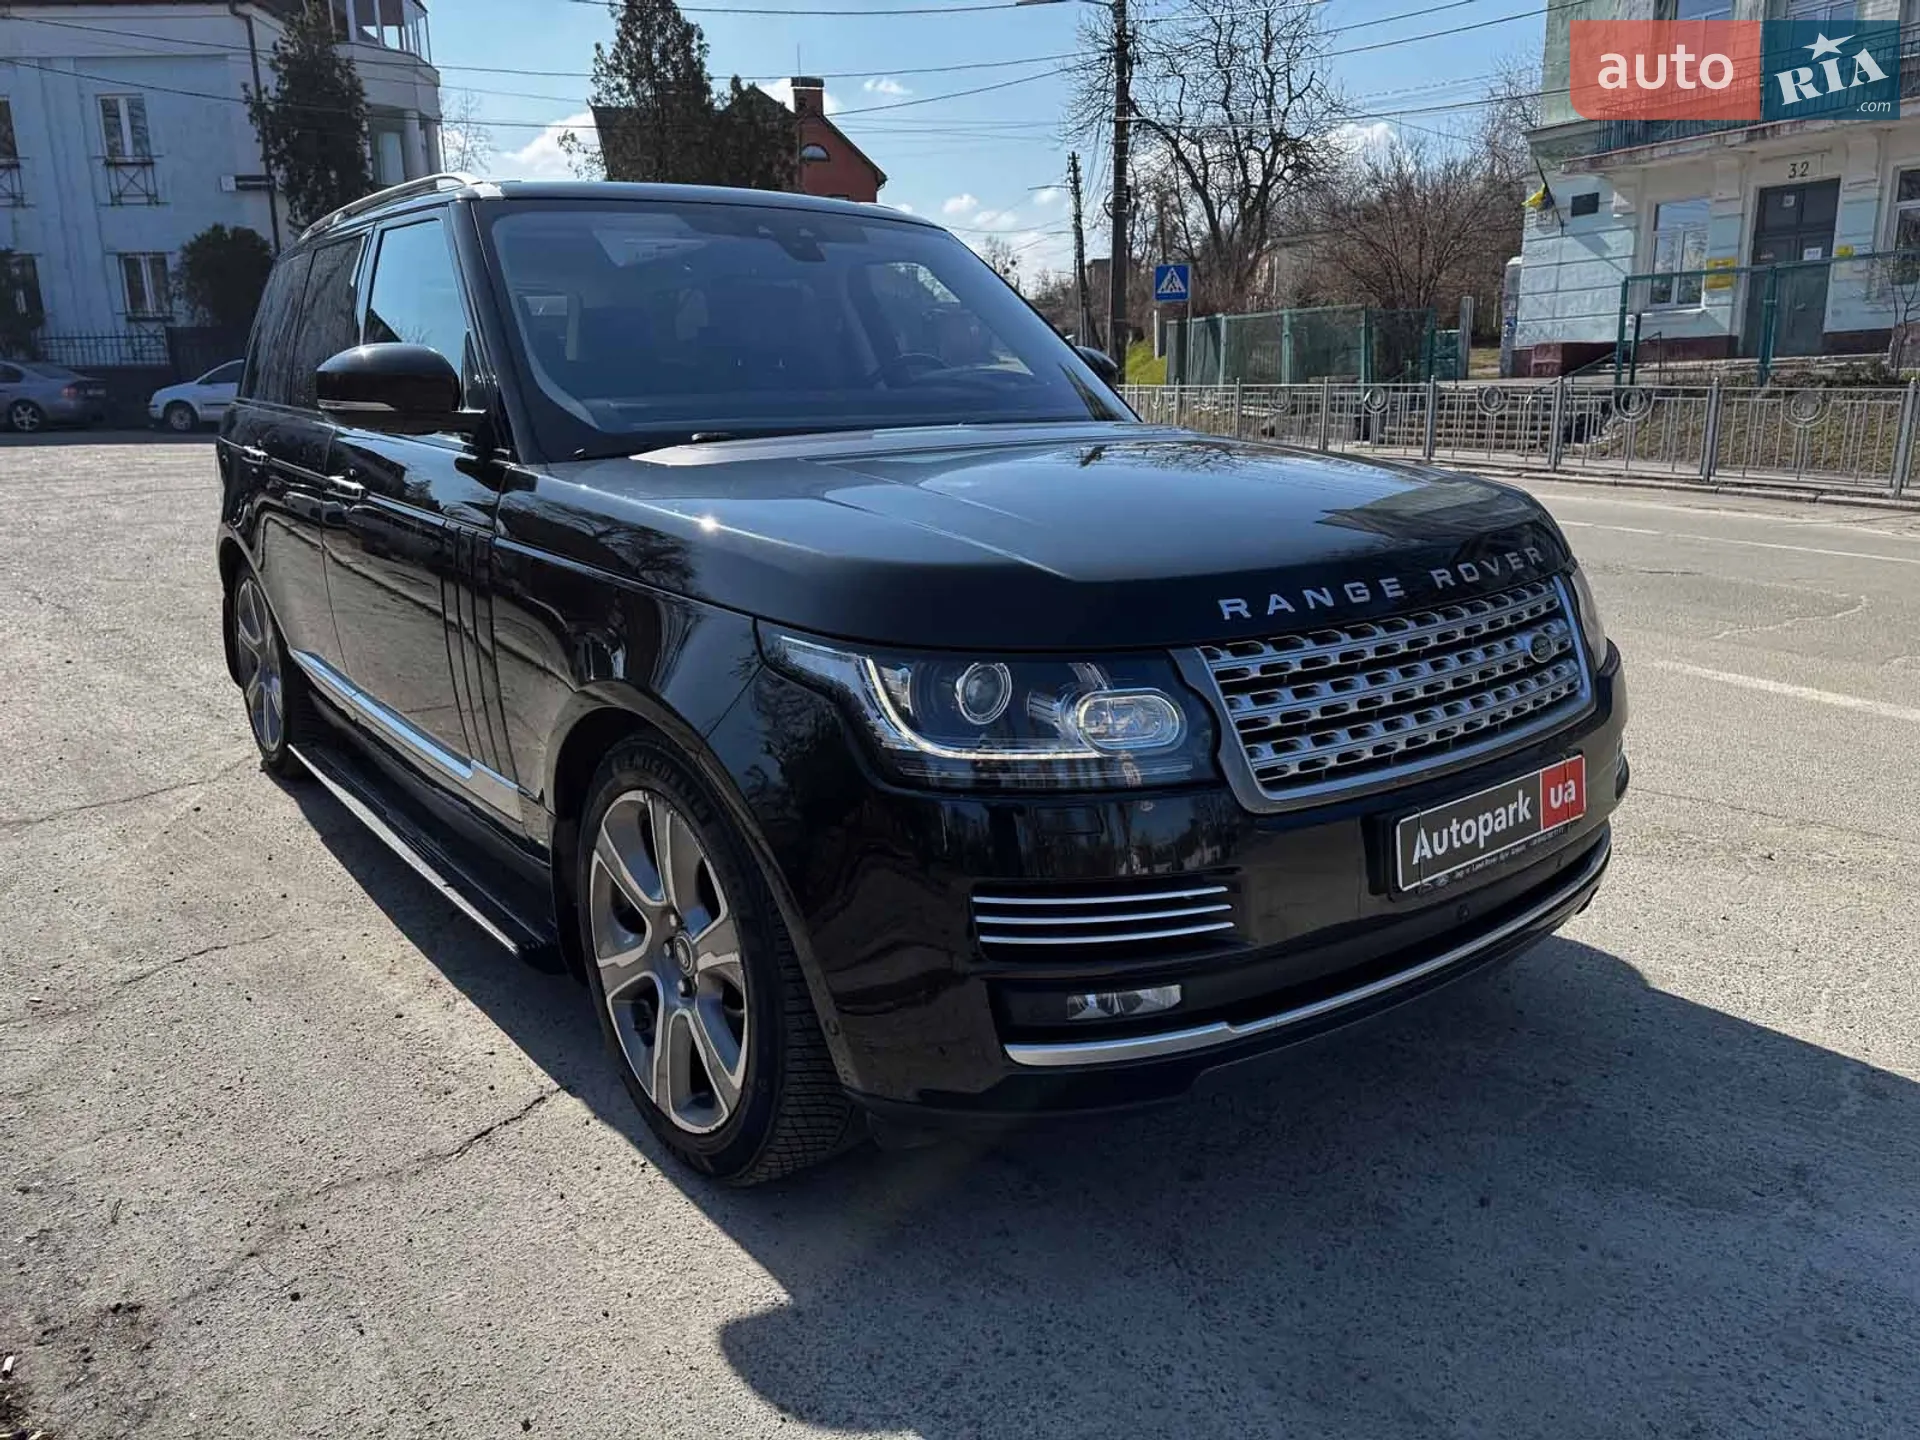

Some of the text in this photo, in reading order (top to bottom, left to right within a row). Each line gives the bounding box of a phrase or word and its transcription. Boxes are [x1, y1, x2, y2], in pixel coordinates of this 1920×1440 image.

[1788, 161, 1810, 179] 32
[1217, 546, 1546, 621] RANGE ROVER
[1412, 789, 1532, 866] Autopark
[1549, 778, 1577, 810] ua
